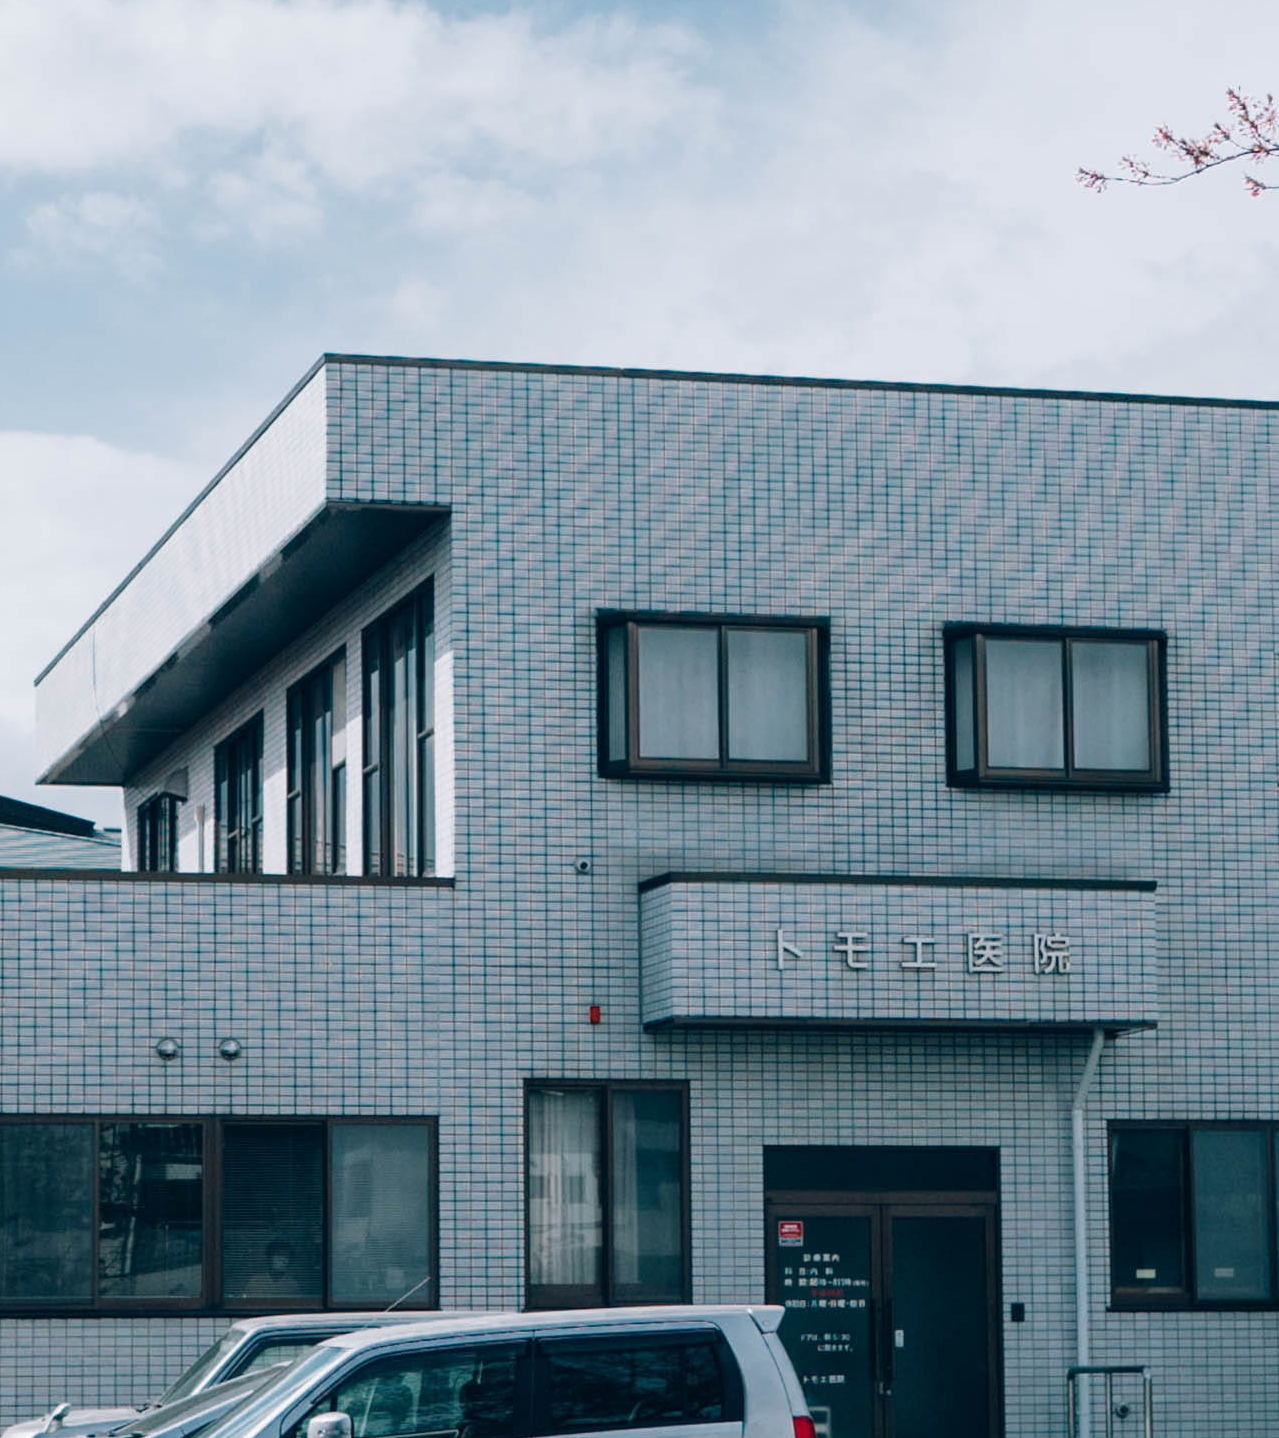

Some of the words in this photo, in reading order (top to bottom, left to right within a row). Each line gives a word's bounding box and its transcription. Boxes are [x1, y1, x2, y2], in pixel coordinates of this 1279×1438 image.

[776, 928, 1071, 973] トモエ医院
